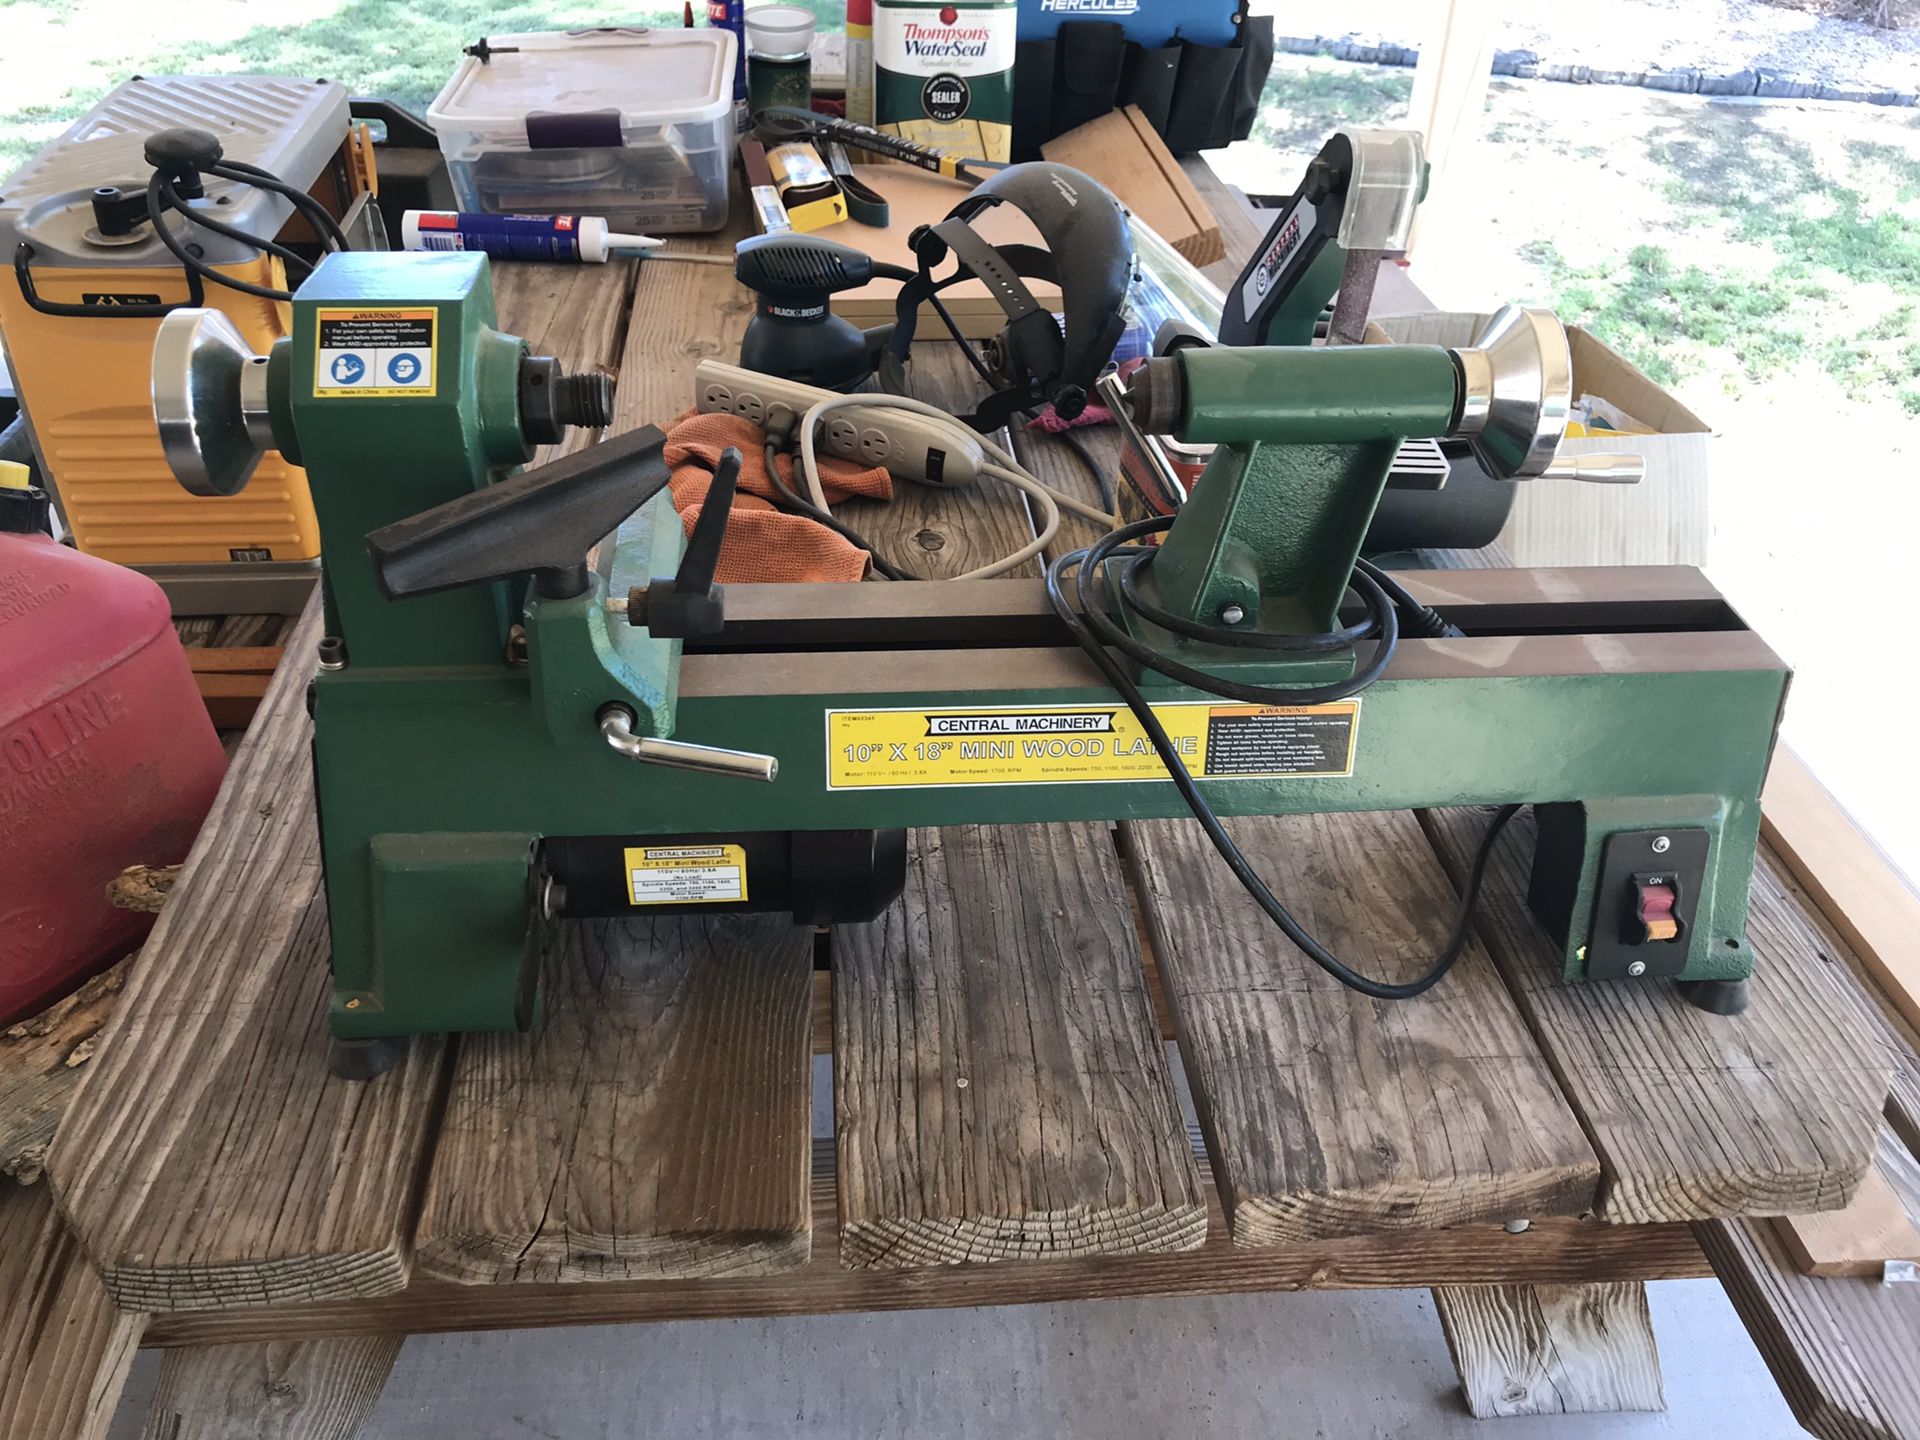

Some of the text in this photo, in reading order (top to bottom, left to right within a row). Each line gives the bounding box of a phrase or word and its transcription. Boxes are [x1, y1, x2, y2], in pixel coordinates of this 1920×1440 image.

[1040, 0, 1137, 11] HERCULES
[903, 23, 991, 44] Thompson's
[904, 40, 988, 57] WaterSeal
[931, 91, 961, 104] SEALER
[938, 716, 1103, 732] CENTRAL MACHINERY
[888, 742, 908, 761] X
[959, 740, 1015, 760] MINI
[1022, 738, 1105, 758] WOOD
[682, 849, 720, 857] MACHINERY
[1649, 877, 1663, 885] ON
